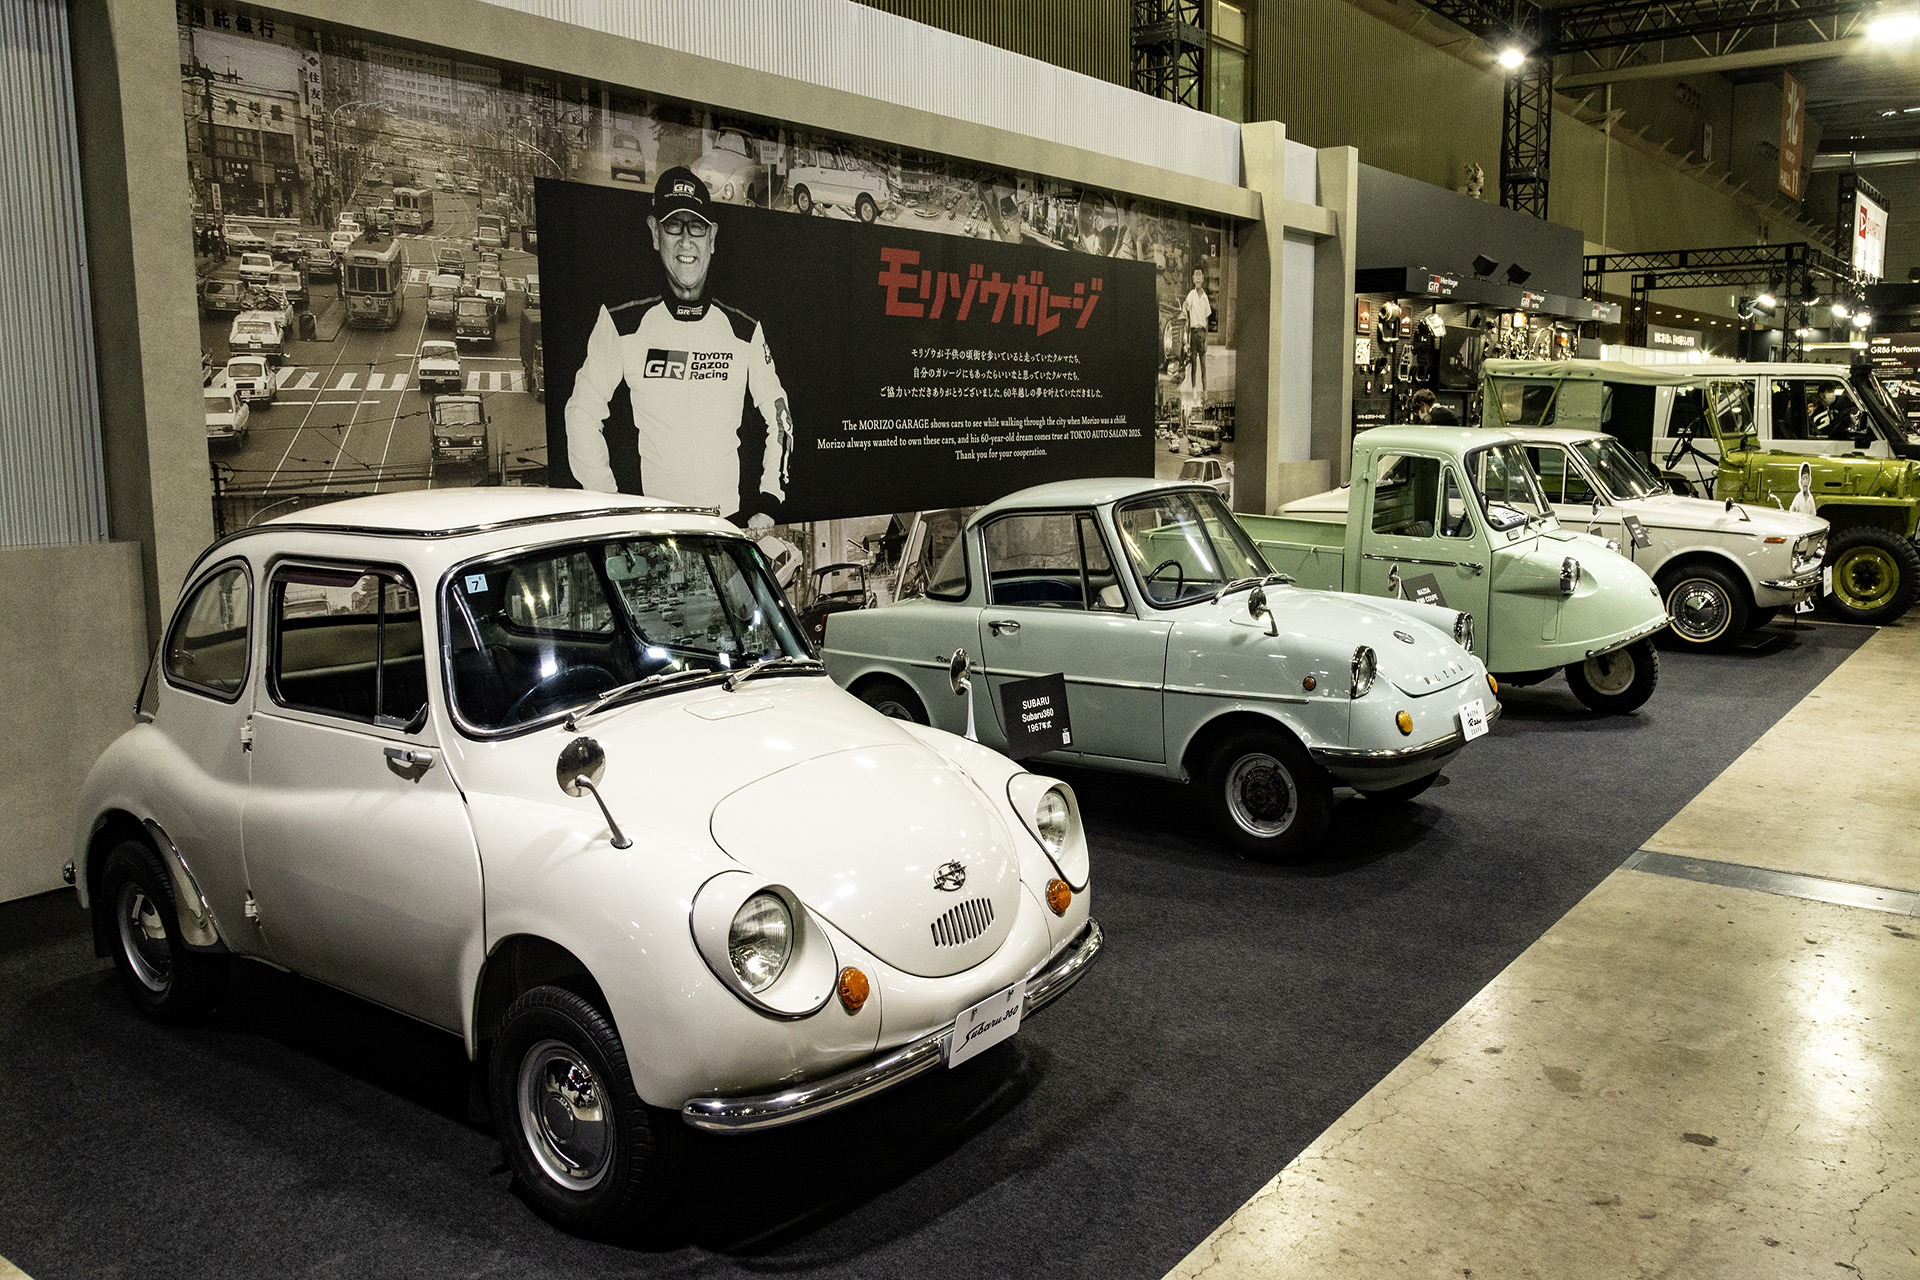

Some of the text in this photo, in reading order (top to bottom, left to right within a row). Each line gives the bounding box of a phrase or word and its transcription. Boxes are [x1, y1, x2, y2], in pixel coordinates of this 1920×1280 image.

[1440, 276, 1458, 288] Heritage
[878, 247, 1103, 337] モリゾウガレージ
[1440, 286, 1451, 294] Parts
[1870, 346, 1890, 354] GR86
[644, 352, 733, 380] GR TOYOTA
[691, 361, 729, 371] GAZOO
[690, 370, 728, 381] Racing
[842, 420, 857, 430] The
[859, 419, 894, 430] MORIZO
[895, 418, 929, 429] GARAGE
[930, 418, 950, 428] shows
[951, 420, 964, 428] cars
[983, 417, 999, 427] while
[1001, 416, 1023, 429] walking
[1024, 416, 1046, 429] through
[1056, 417, 1066, 428] city
[1067, 415, 1080, 425] when
[1081, 415, 1100, 425] Morizo
[1114, 415, 1127, 424] child.
[817, 438, 845, 449] Morizo
[847, 437, 871, 450] always
[873, 435, 898, 447] wanted
[908, 437, 922, 445] own
[923, 435, 940, 445] these
[941, 437, 956, 446] cars,
[957, 433, 969, 444] and
[970, 433, 979, 443] his
[981, 431, 1014, 445] 60-year-old
[1015, 431, 1033, 441] dream
[1034, 432, 1050, 441] comes
[1052, 432, 1063, 440] true
[1070, 430, 1091, 440] TOKYO
[1091, 429, 1108, 439] AUTO
[1109, 429, 1128, 438] SALON
[1128, 428, 1142, 437] 2025.
[955, 447, 1047, 462] Thank you for your cooperation.
[471, 581, 479, 591] 7
[1022, 696, 1050, 710] SUBARU
[1021, 708, 1054, 722] Subaru360
[1027, 720, 1052, 733] 1967年式
[956, 1005, 1019, 1053] Subaru 360
